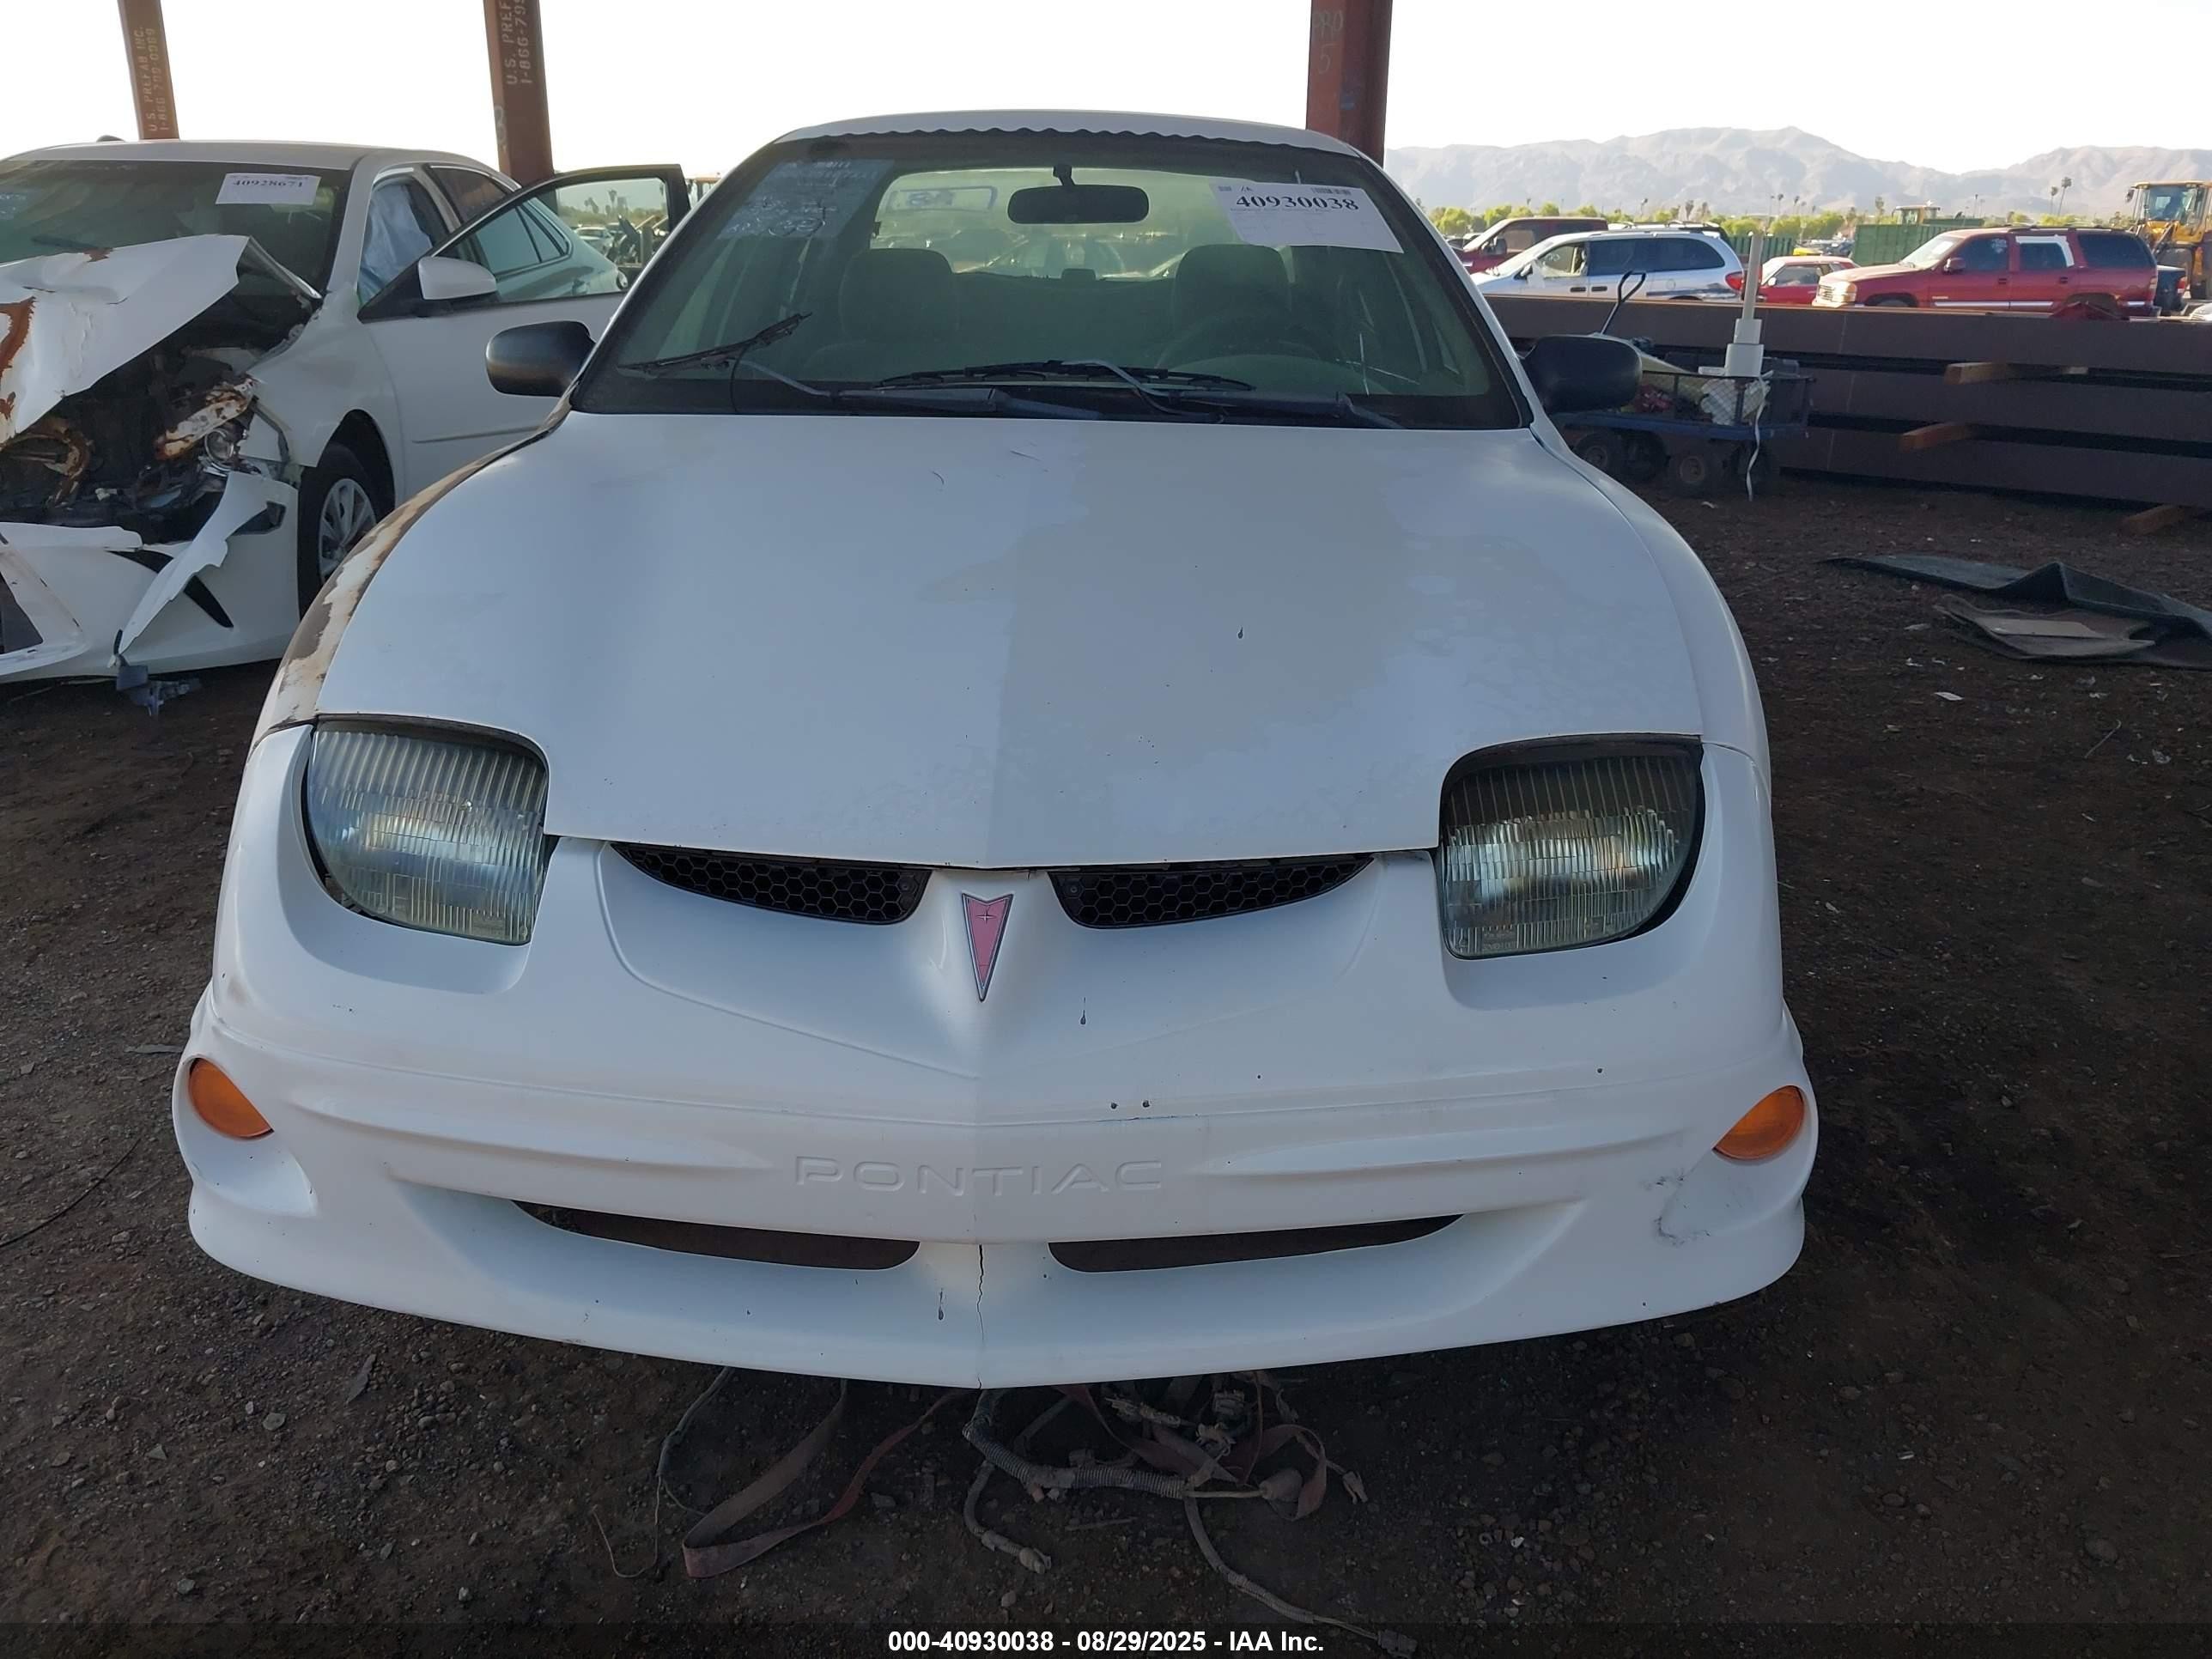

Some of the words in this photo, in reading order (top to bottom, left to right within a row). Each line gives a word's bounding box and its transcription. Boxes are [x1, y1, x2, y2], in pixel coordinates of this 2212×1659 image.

[503, 52, 518, 85] U.S.
[1236, 195, 1359, 210] 40930038
[795, 1155, 1163, 1197] PONTIAC
